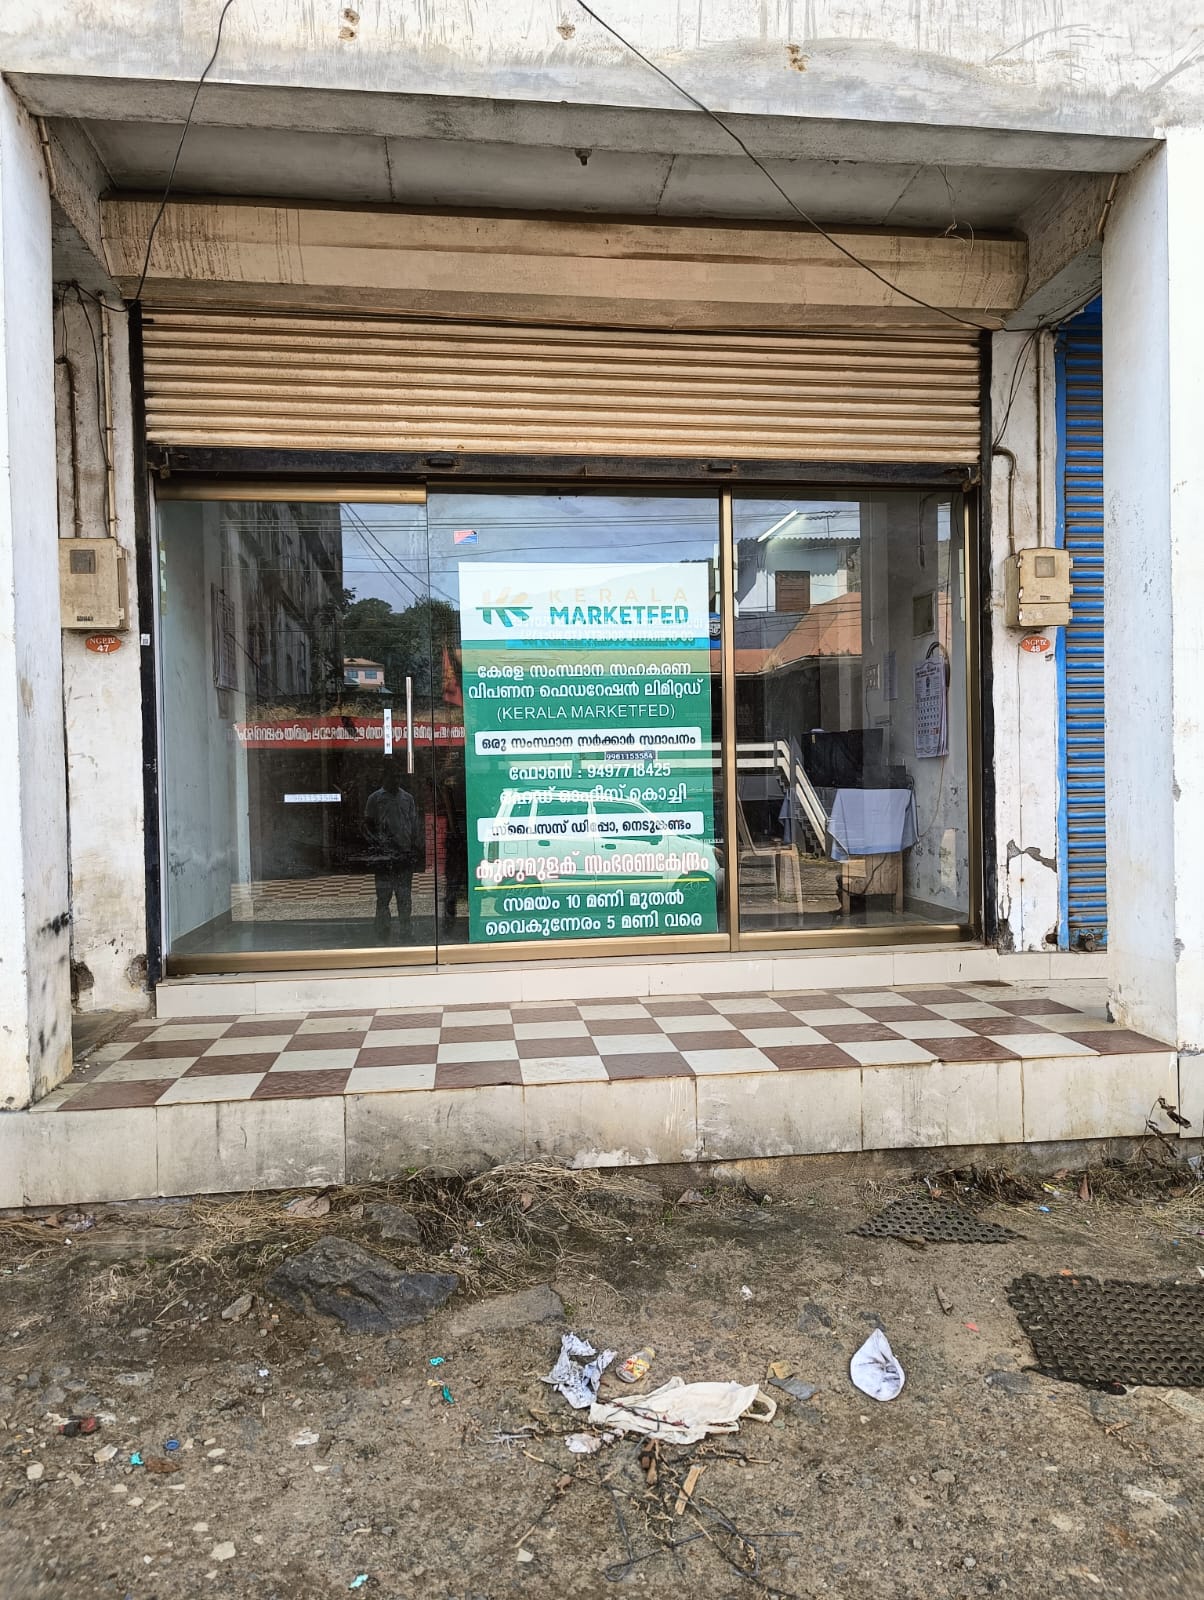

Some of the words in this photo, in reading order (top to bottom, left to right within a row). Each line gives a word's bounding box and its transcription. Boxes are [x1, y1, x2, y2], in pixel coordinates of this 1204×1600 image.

[549, 586, 688, 604] KERALA
[549, 604, 689, 625] MARKETFED
[97, 644, 110, 652] 47
[477, 665, 525, 681] കേരള
[529, 663, 604, 678] സംസ്ഥാന
[609, 662, 691, 677] സഹകരണ
[468, 681, 535, 699] വിപണന
[539, 680, 640, 698] ഫെഡറേഷൻ
[644, 677, 704, 699] ലിമിറ്റഡ്
[497, 705, 568, 723] (KERALA
[571, 703, 675, 720] MARKETFED)
[481, 737, 507, 752] ഒരു
[511, 736, 573, 749] സംസ്ഥാന
[577, 732, 635, 747] സർക്കാർ
[639, 734, 696, 746] സ്ഥാപനം
[508, 763, 573, 781] ഫോൺ
[587, 762, 671, 778] 9497718425
[629, 782, 687, 804] കൊച്ചി
[476, 850, 581, 883] കുരുമുളക്
[584, 851, 709, 875] സംഭരണകേന്ദ്രം
[503, 895, 560, 912] സമയം
[566, 894, 580, 909] 10
[586, 889, 624, 909] മണി
[629, 888, 684, 910] മുതൽ
[485, 915, 601, 936] വൈകുന്നേരം
[607, 916, 615, 930] 5
[621, 910, 659, 929] മണി
[664, 911, 702, 928] വരെ
